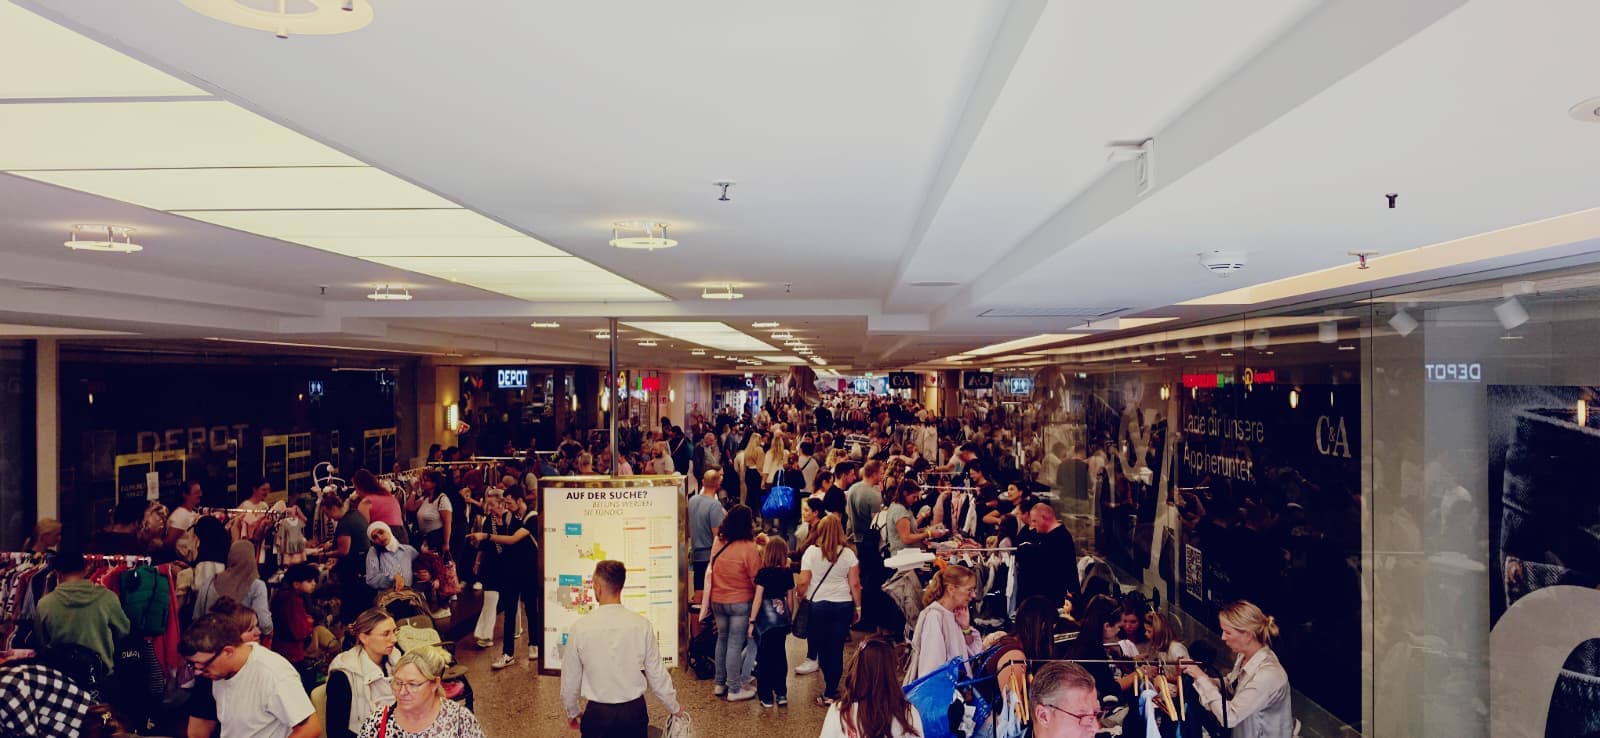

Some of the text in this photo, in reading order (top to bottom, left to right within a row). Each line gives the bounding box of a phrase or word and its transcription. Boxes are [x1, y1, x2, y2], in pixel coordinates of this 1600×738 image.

[498, 370, 528, 387] DEPOT
[137, 424, 249, 457] DEPOT
[1183, 407, 1264, 443] Lade dir unsere
[1315, 415, 1351, 459] C&A
[1184, 440, 1203, 477] App
[566, 490, 648, 500] AUF DER SUCHE?
